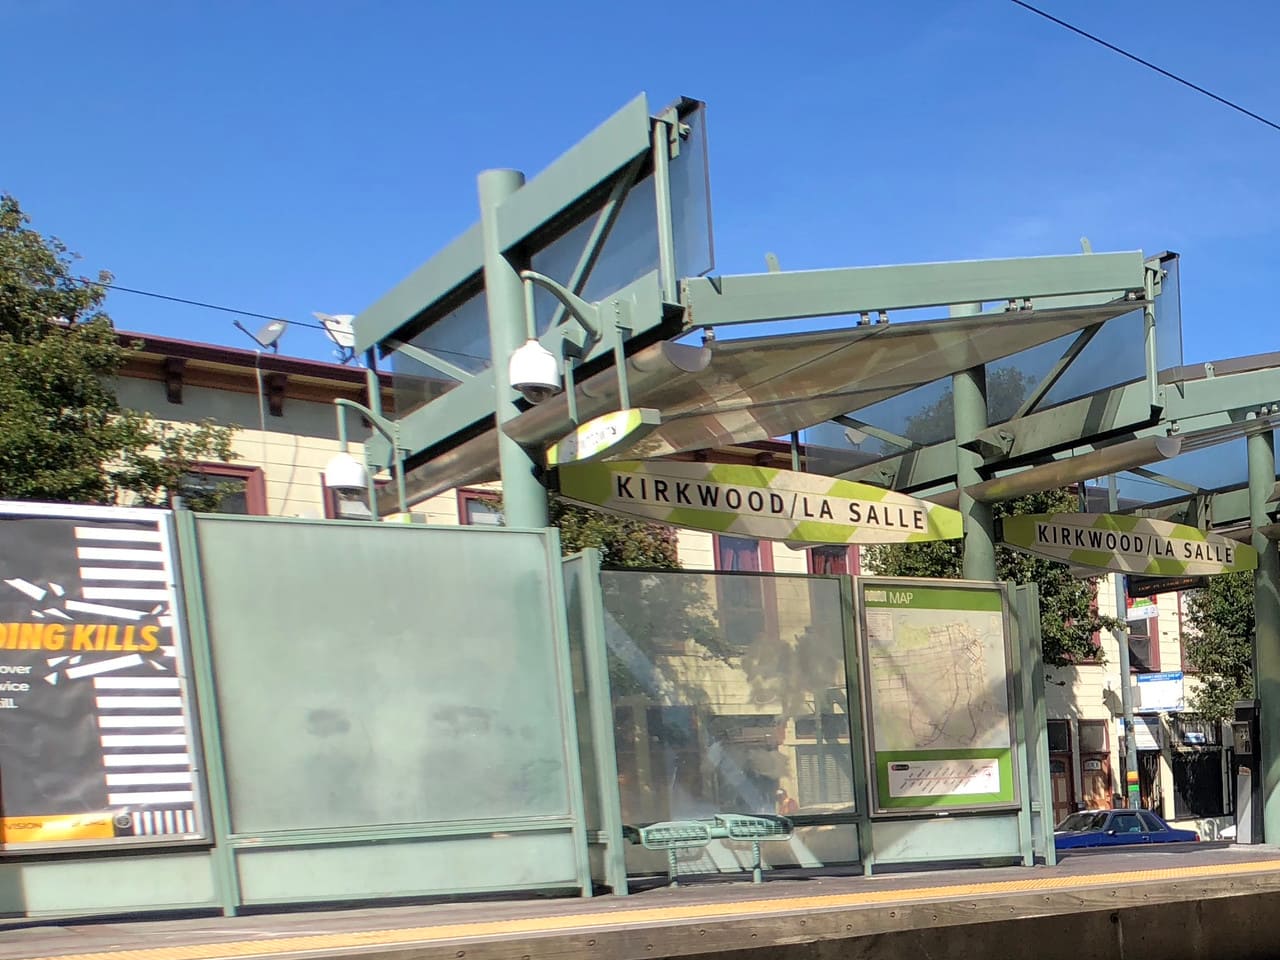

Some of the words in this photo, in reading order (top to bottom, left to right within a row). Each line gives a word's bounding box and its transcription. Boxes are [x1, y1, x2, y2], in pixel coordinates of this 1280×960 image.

[617, 475, 835, 520] KIRKWOOD/LA
[849, 501, 925, 530] SALLE
[1038, 524, 1174, 557] KIRKWOOD/LA
[1184, 542, 1233, 563] SALLE
[889, 592, 913, 604] MAP
[72, 624, 160, 652] KILLS
